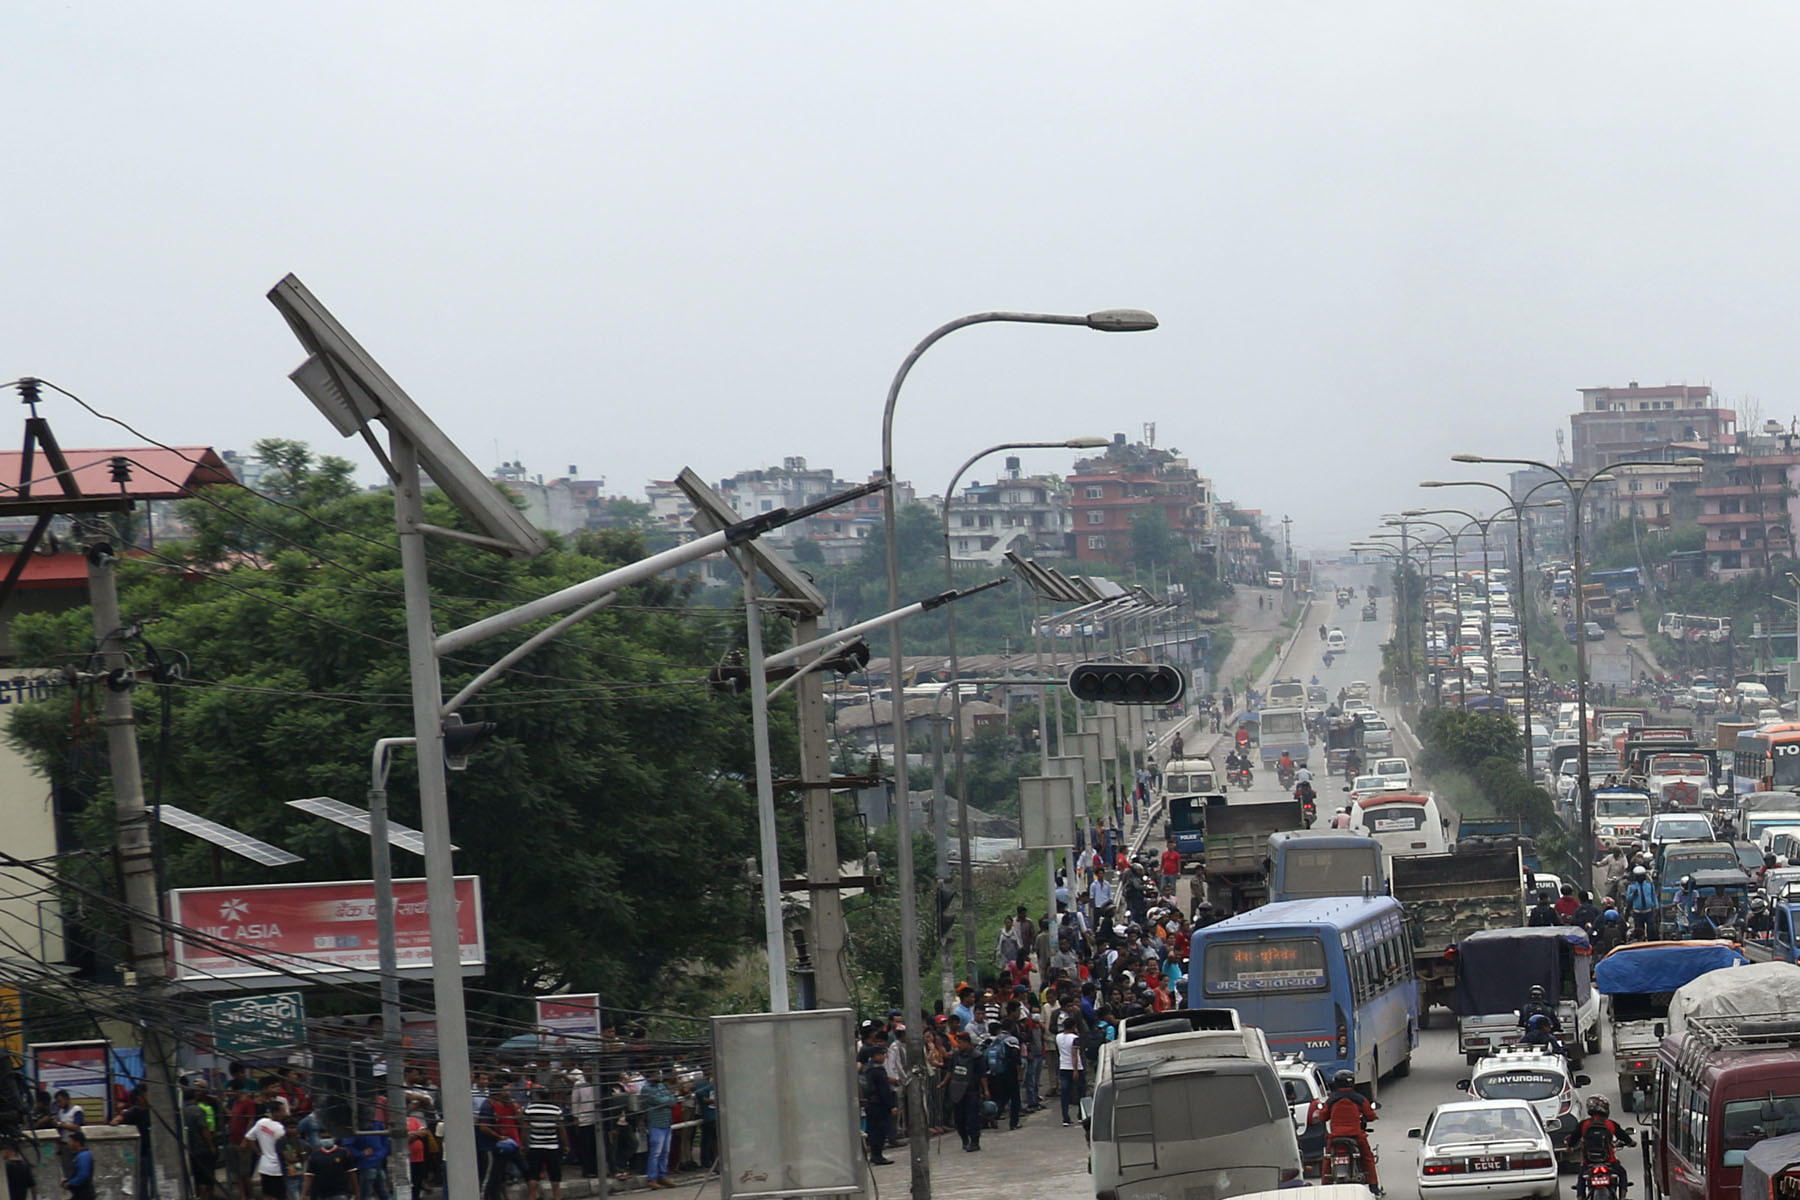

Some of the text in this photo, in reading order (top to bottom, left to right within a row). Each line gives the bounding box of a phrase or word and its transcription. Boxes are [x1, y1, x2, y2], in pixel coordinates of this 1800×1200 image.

[198, 923, 283, 940] NIC ASIA
[1306, 1041, 1331, 1049] TATA
[1498, 1075, 1544, 1083] HYUNDAI
